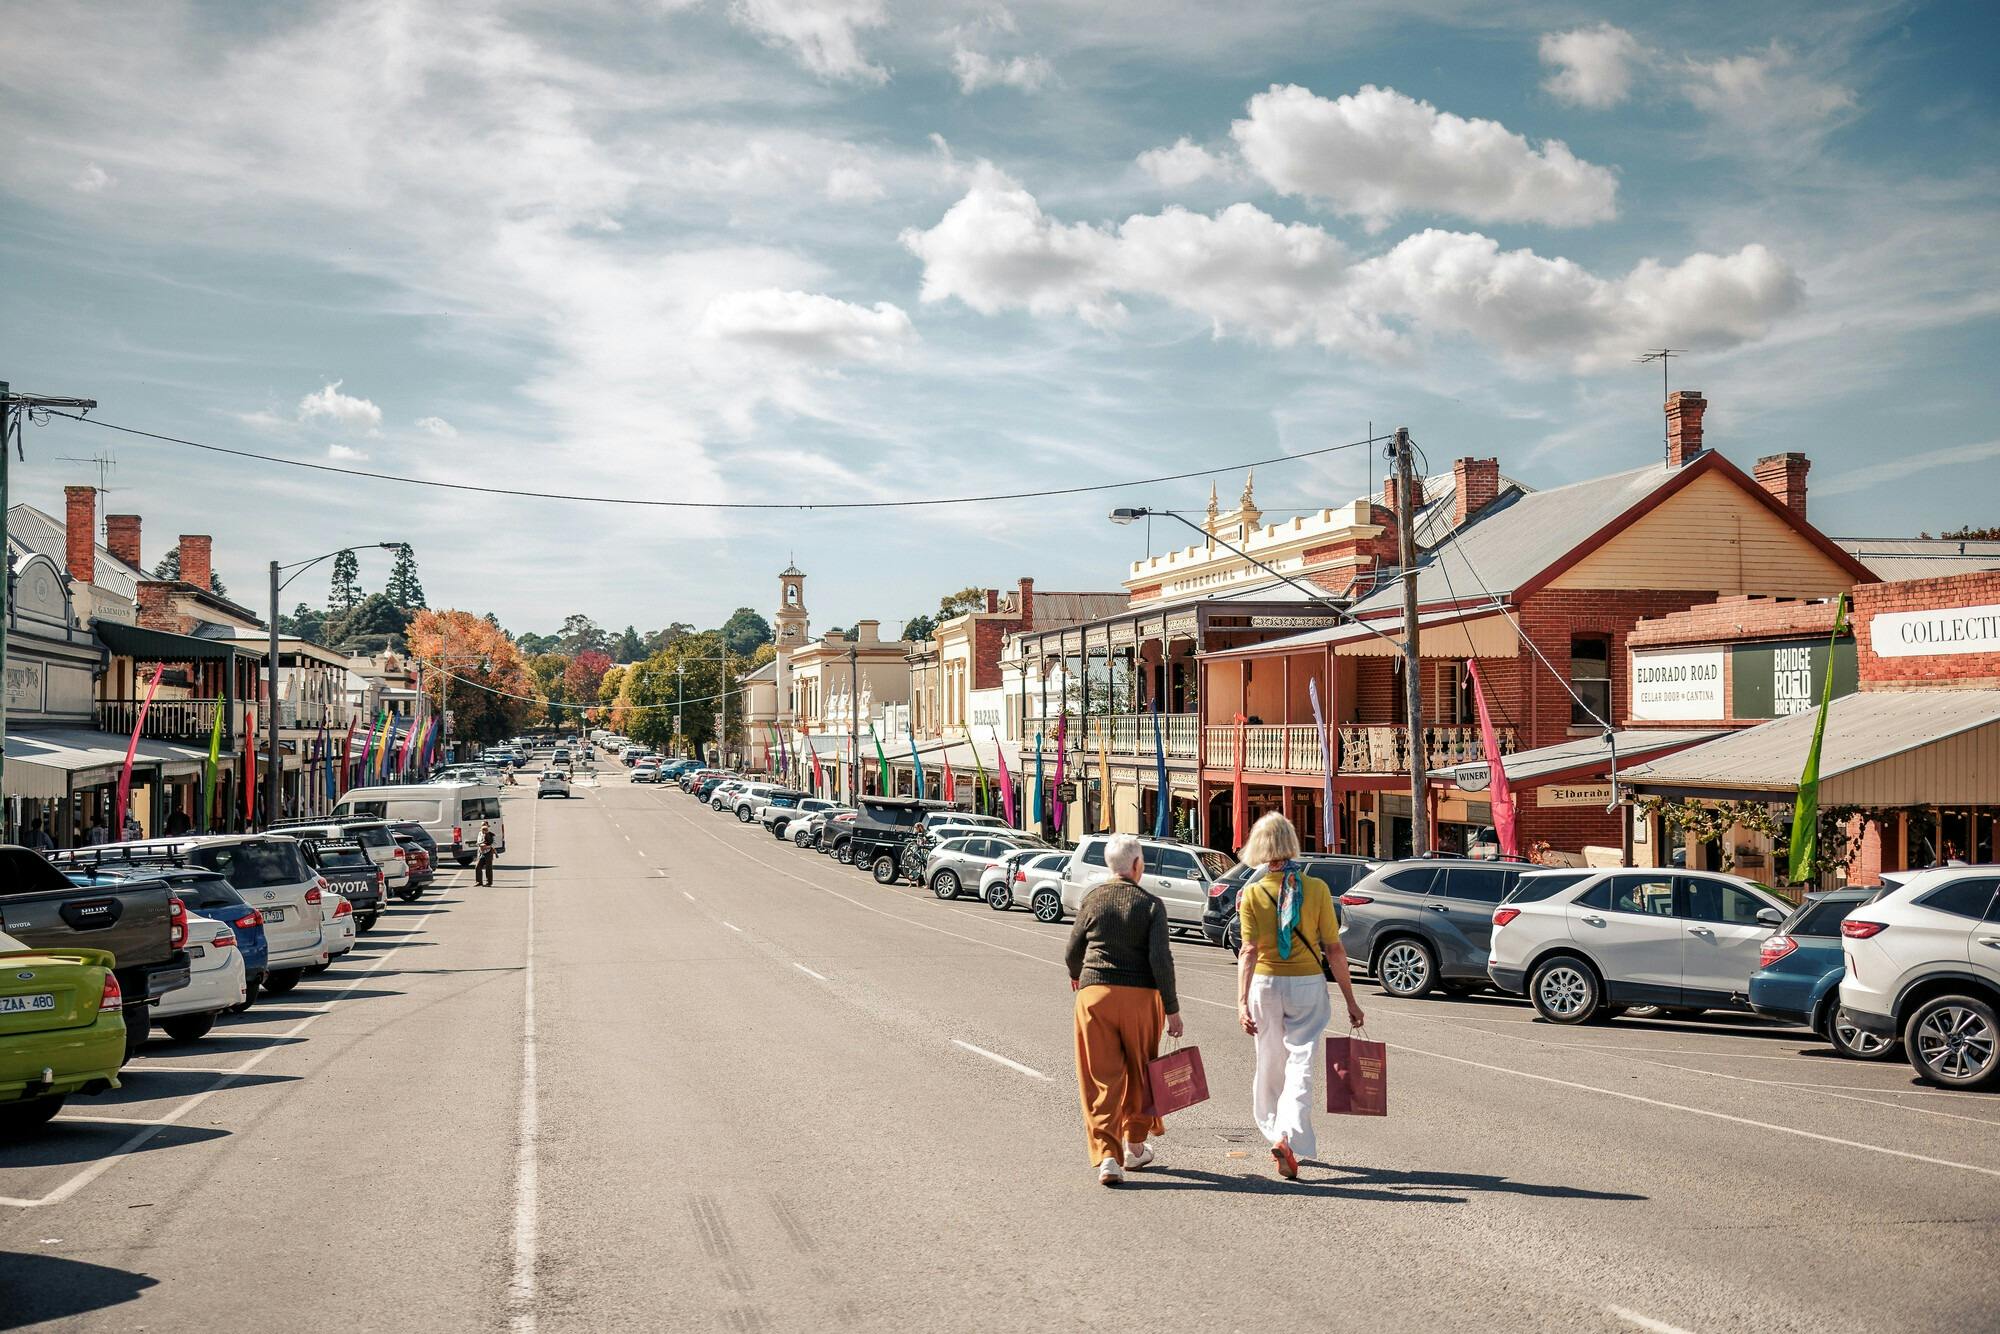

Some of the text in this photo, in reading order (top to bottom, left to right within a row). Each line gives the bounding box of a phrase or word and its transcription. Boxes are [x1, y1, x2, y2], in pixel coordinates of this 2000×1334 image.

[1174, 569, 1235, 591] COMMERCIAL
[1774, 647, 1811, 671] BRIDGE
[1637, 664, 1718, 683] ELDORADO ROAD
[1640, 689, 1714, 703] CELLAR DOOR CANTINA
[974, 709, 1001, 726] BAZAAR
[1458, 771, 1489, 781] WINERY
[1551, 788, 1610, 800] Eldorado
[327, 880, 369, 894] OYOTA
[9, 921, 32, 929] TOYOTA
